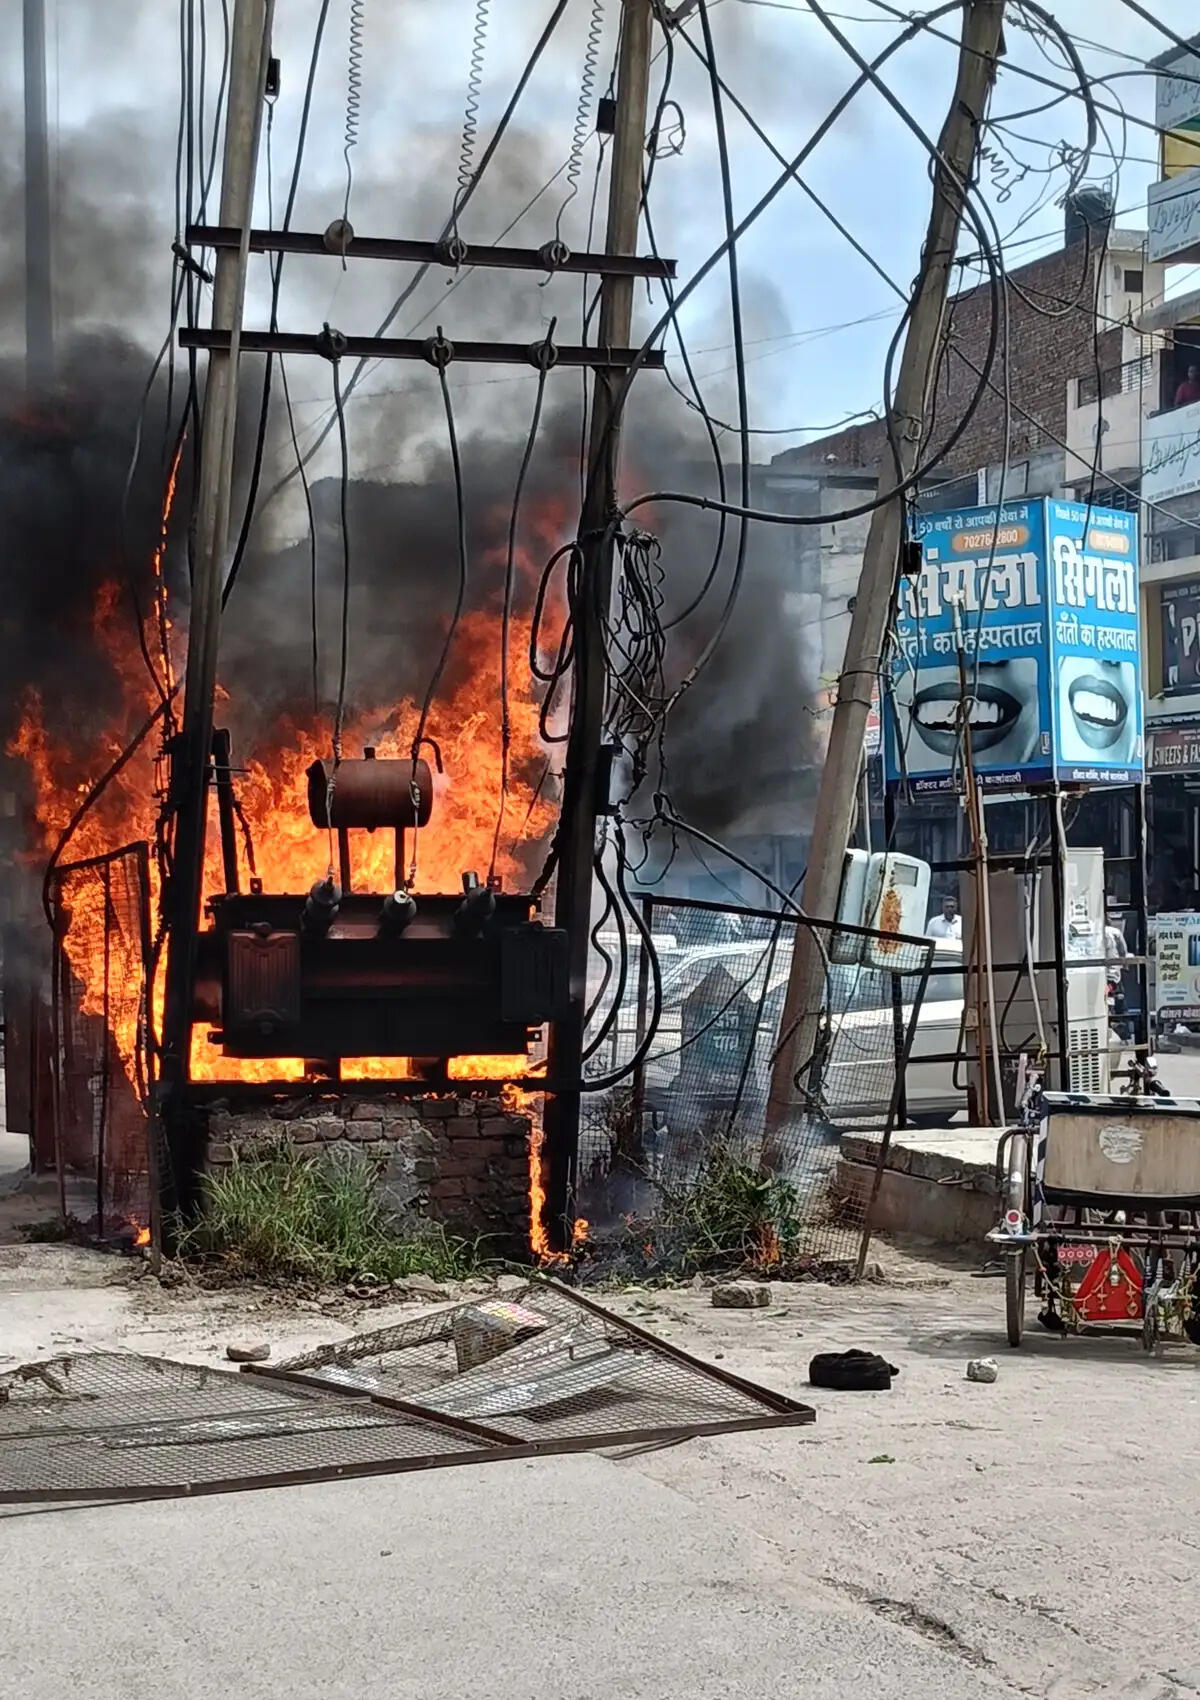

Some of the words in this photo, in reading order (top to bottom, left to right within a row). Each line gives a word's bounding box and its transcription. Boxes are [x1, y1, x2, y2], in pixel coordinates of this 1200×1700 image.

[1053, 535, 1137, 615] सिंगला
[932, 631, 958, 655] का
[963, 622, 1043, 655] हस्पताल
[1080, 624, 1096, 648] का
[1095, 626, 1138, 652] हस्पताल
[1154, 744, 1182, 766] SWEETS
